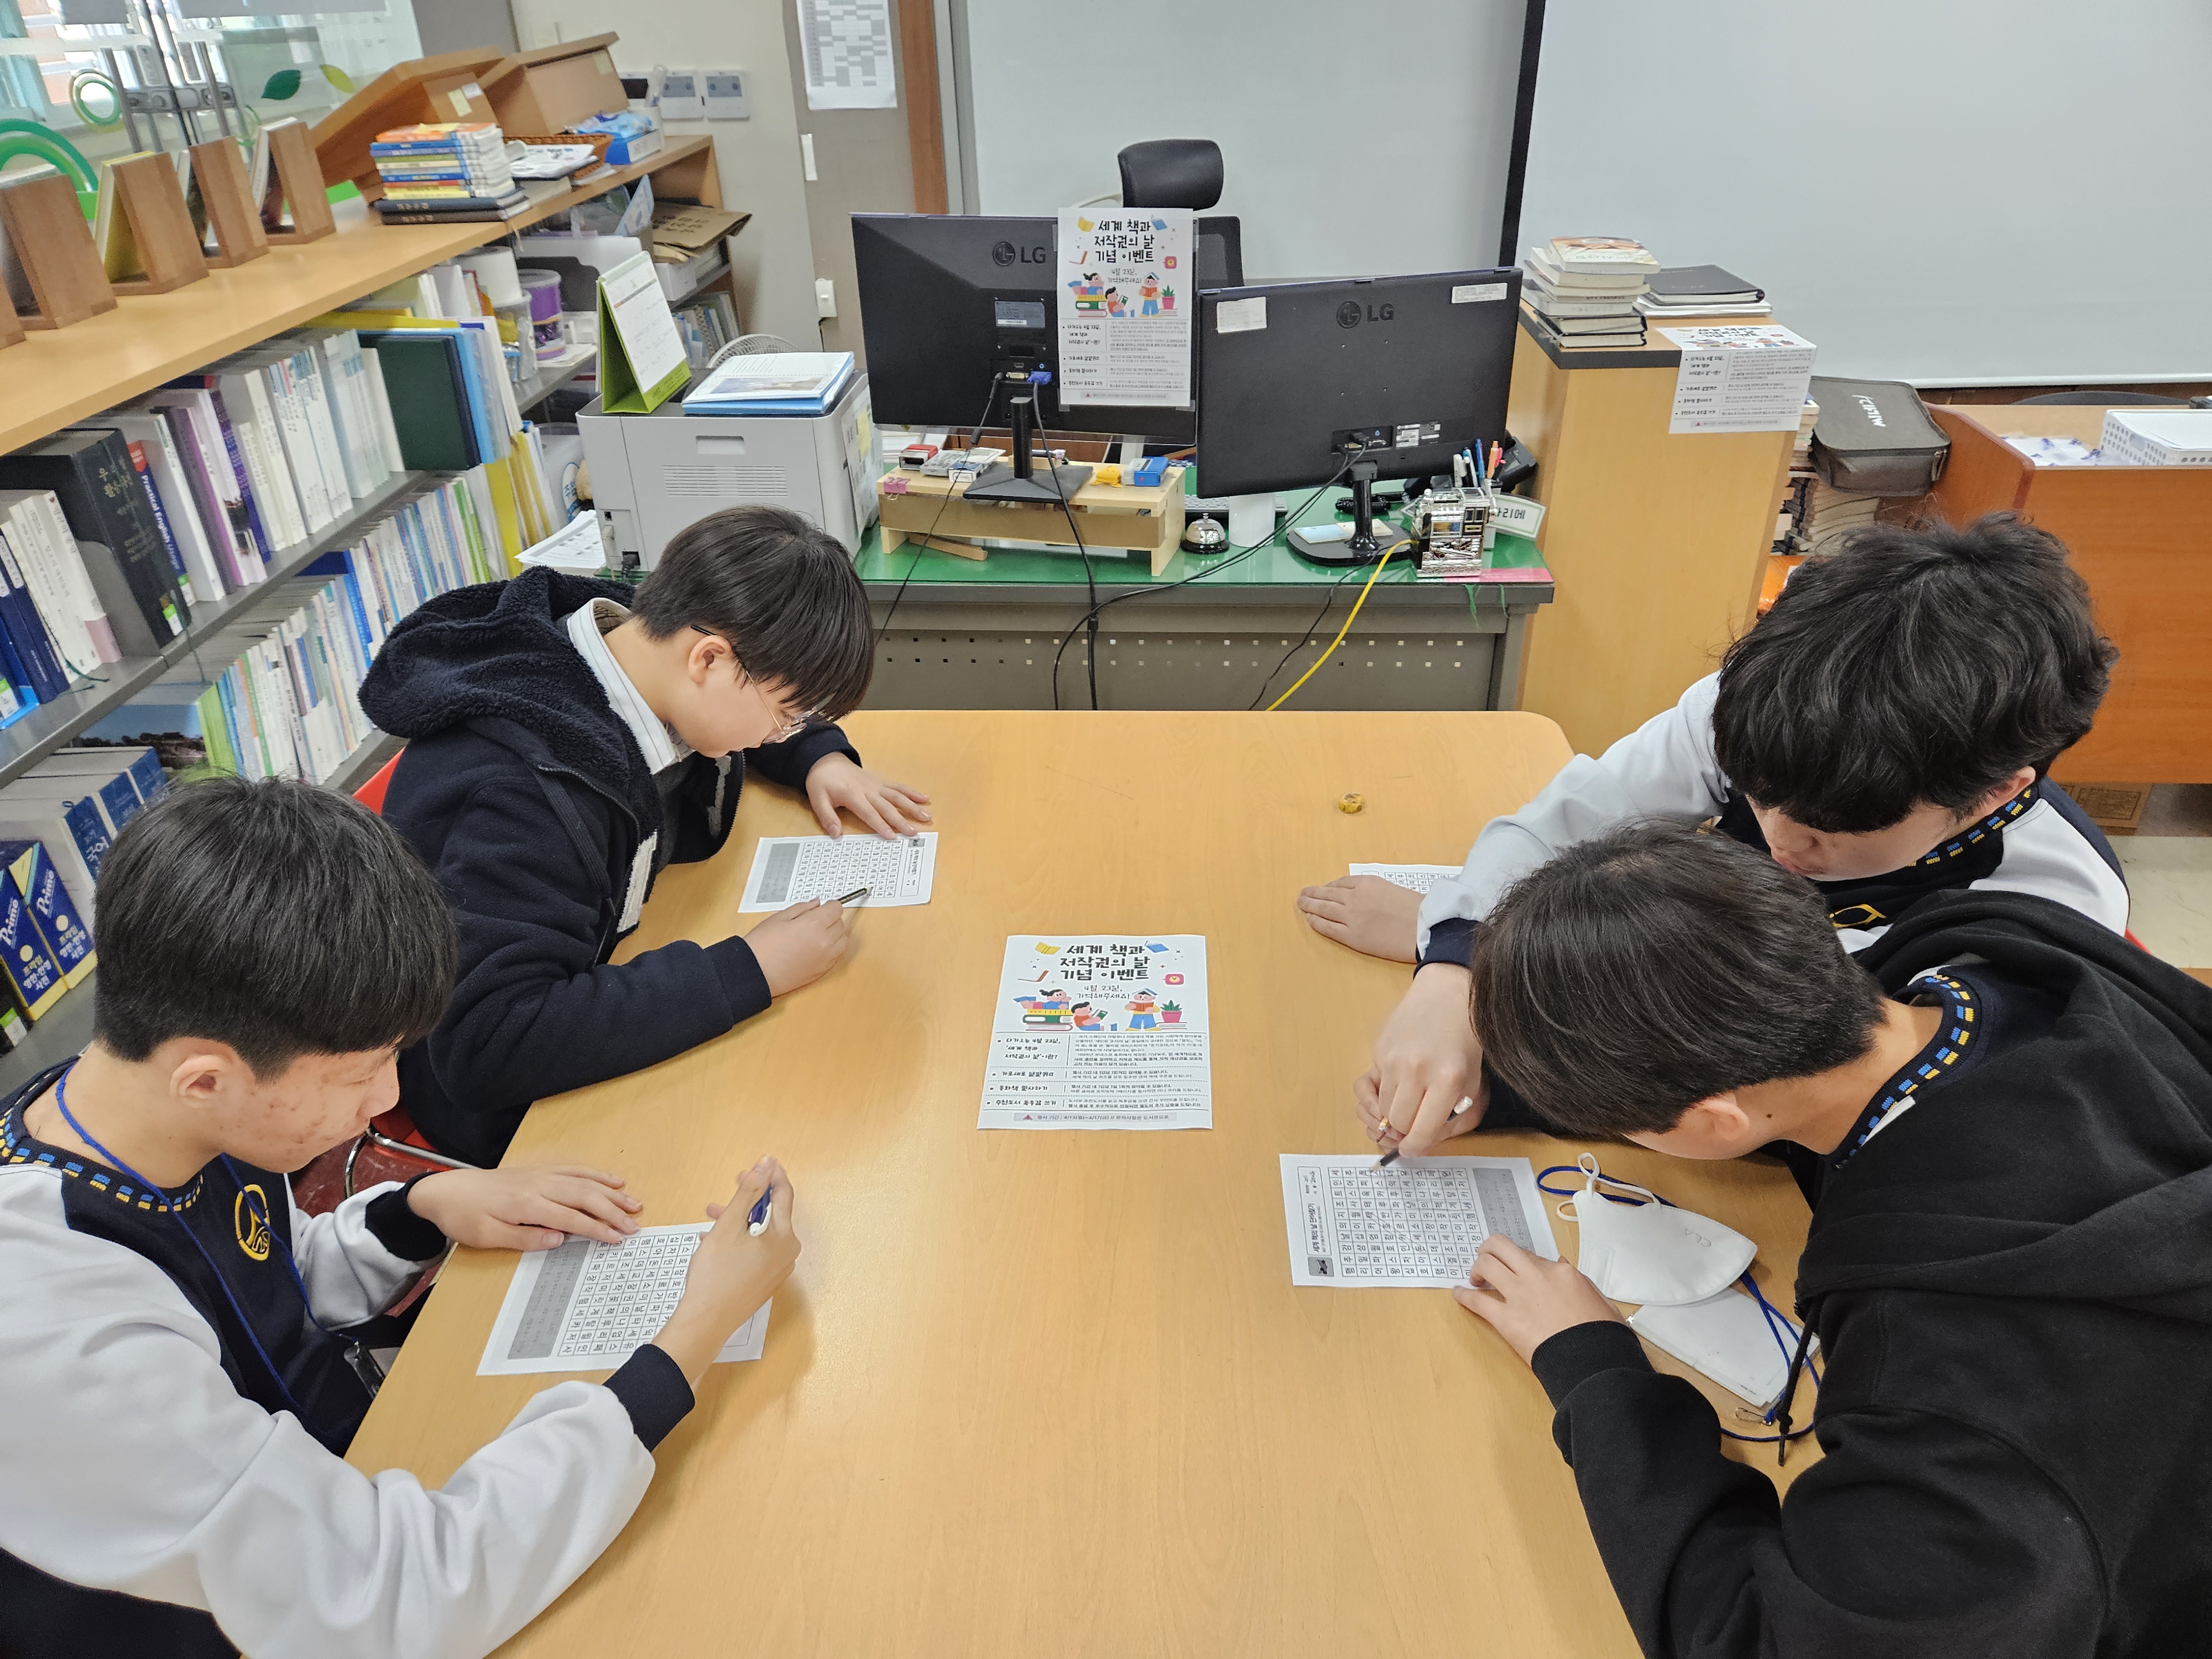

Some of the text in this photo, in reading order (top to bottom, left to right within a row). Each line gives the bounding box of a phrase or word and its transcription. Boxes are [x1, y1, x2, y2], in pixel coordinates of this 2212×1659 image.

[1098, 219, 1151, 234] 세계 책과
[1094, 234, 1155, 249] 저작권의 날
[1020, 246, 1046, 264] LG
[1095, 250, 1154, 263] 기념 이벤트
[1367, 303, 1394, 322] LG
[140, 474, 180, 570] Practical English Usage
[37, 869, 54, 915] Prime
[0, 899, 19, 947] Prime
[59, 925, 79, 946] 프라임
[1066, 943, 1145, 957] 세계 책과
[22, 954, 43, 976] 프라임
[1060, 956, 1151, 969] 저작권의 날
[35, 974, 50, 990] 사전
[1060, 969, 1149, 980] 기념 이벤트
[1307, 1203, 1317, 1223] 단어찾기
[1311, 1230, 1318, 1240] 책의
[1312, 1241, 1320, 1253] 세계
